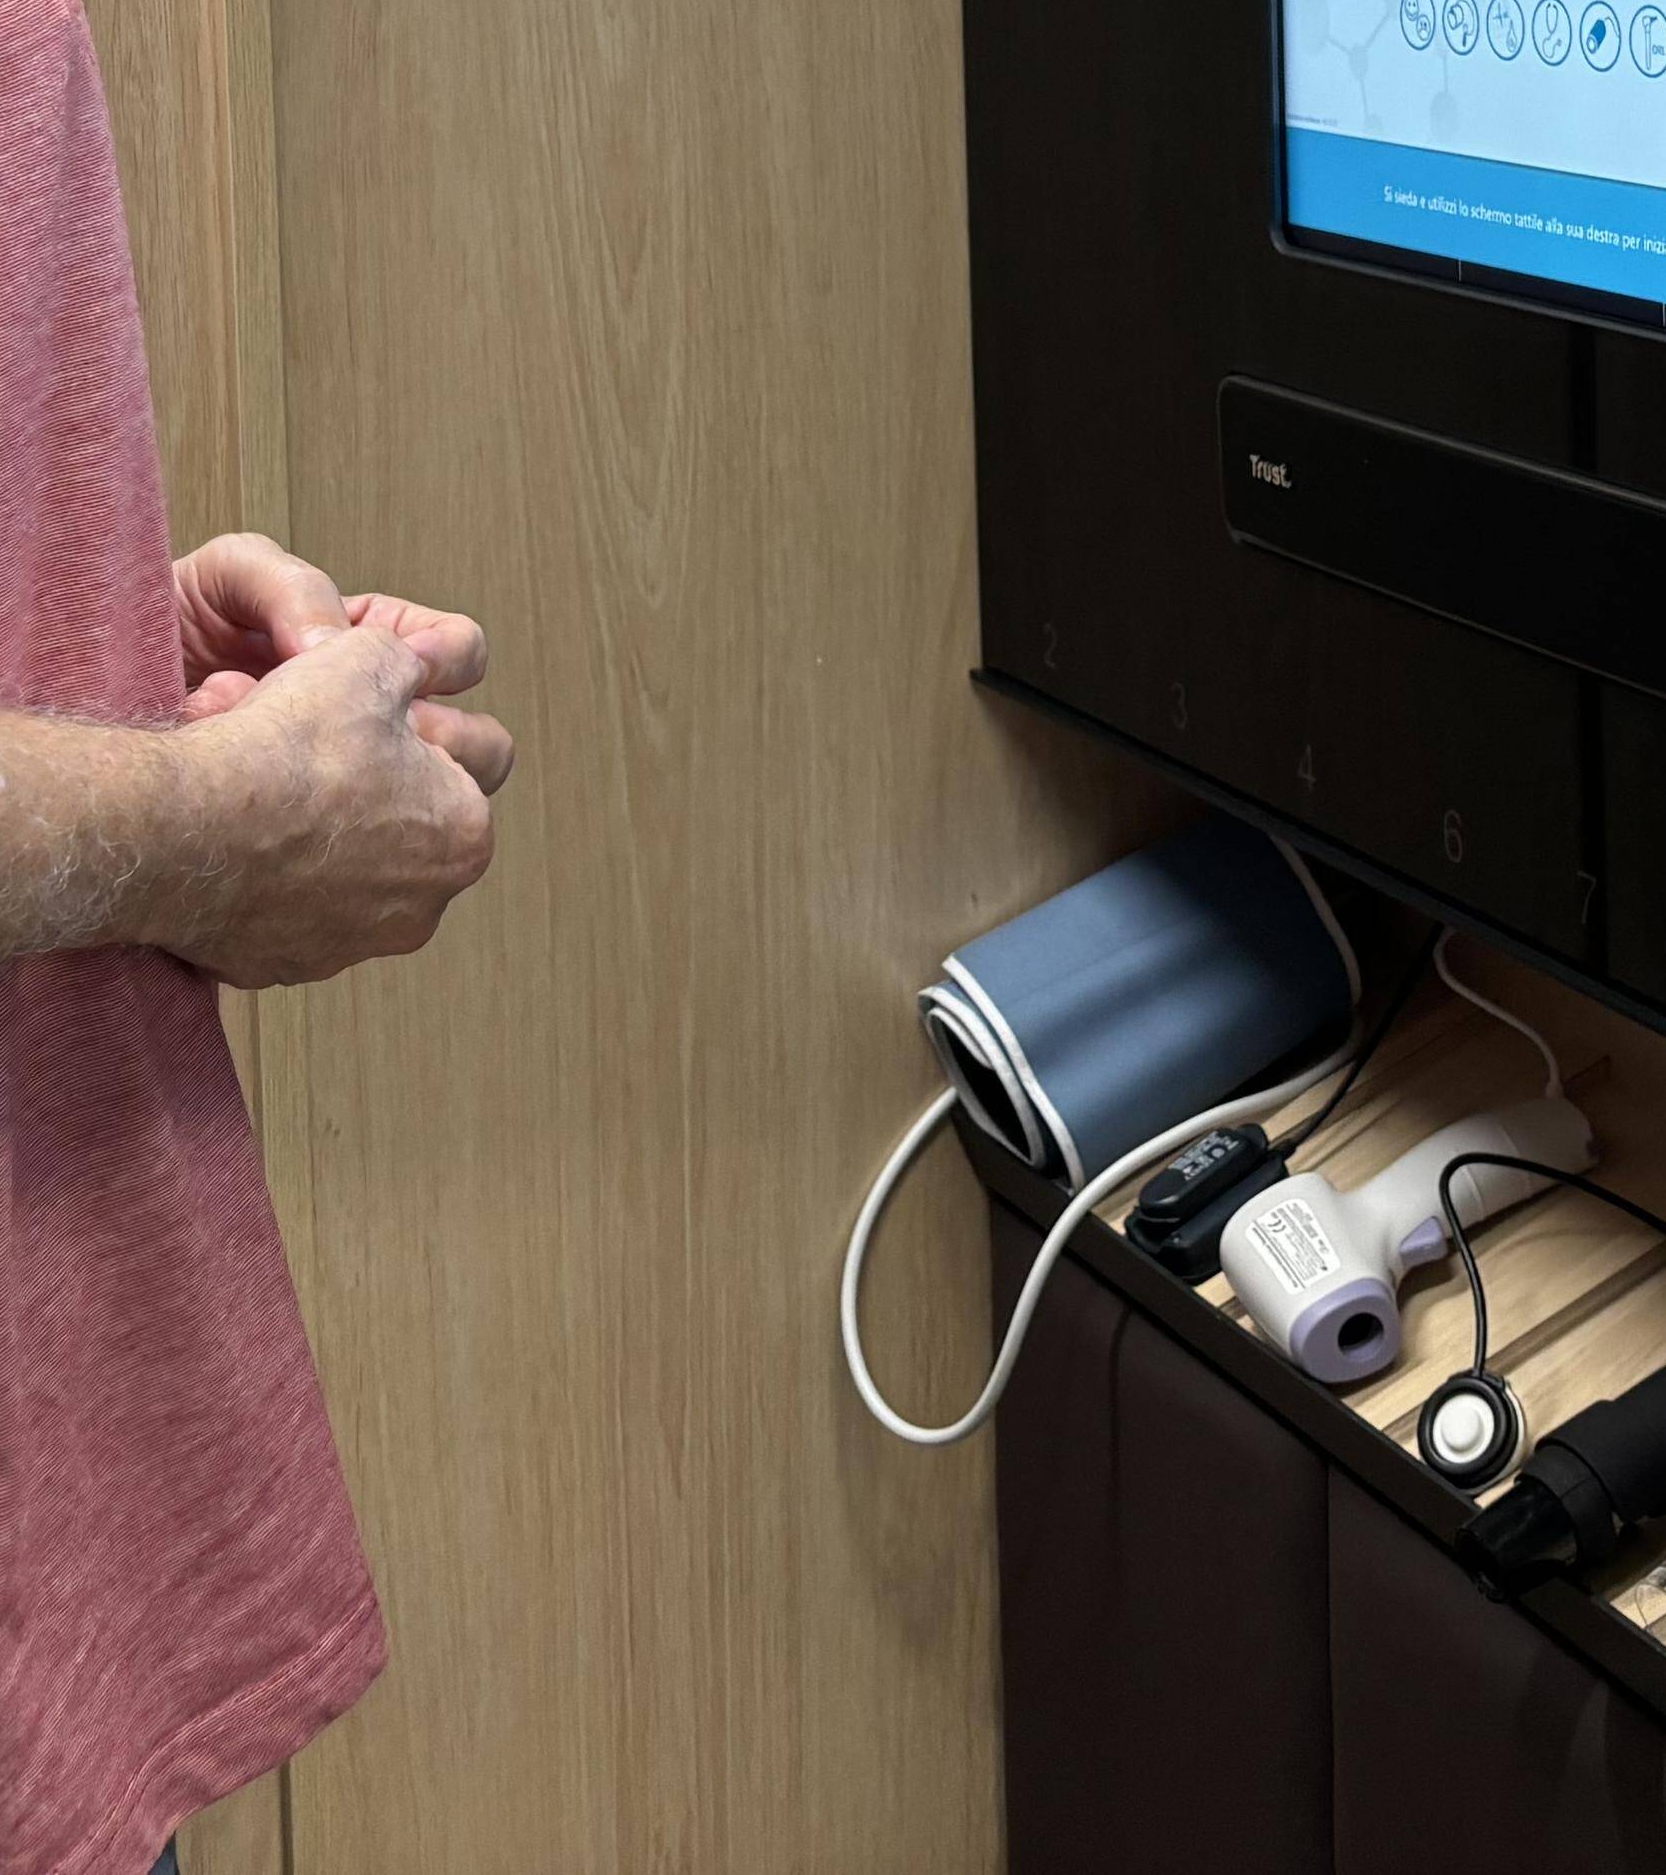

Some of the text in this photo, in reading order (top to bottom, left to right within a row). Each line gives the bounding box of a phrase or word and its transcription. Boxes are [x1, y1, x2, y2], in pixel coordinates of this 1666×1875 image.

[1384, 185, 1393, 202] Si
[1394, 188, 1418, 208] sieda
[1419, 196, 1426, 210] e
[1427, 195, 1457, 216] utilizzi
[1459, 198, 1469, 217] lo
[1470, 202, 1513, 226] schermo
[1514, 212, 1543, 232] tattile
[1545, 217, 1564, 236] alla
[1566, 222, 1584, 240] sua
[1586, 223, 1620, 247] destra
[1622, 234, 1641, 252] per
[1043, 622, 1058, 670] 2
[1171, 681, 1188, 731] 3
[1297, 743, 1317, 795] 4
[1442, 808, 1464, 864] 6
[1576, 869, 1597, 925] 7
